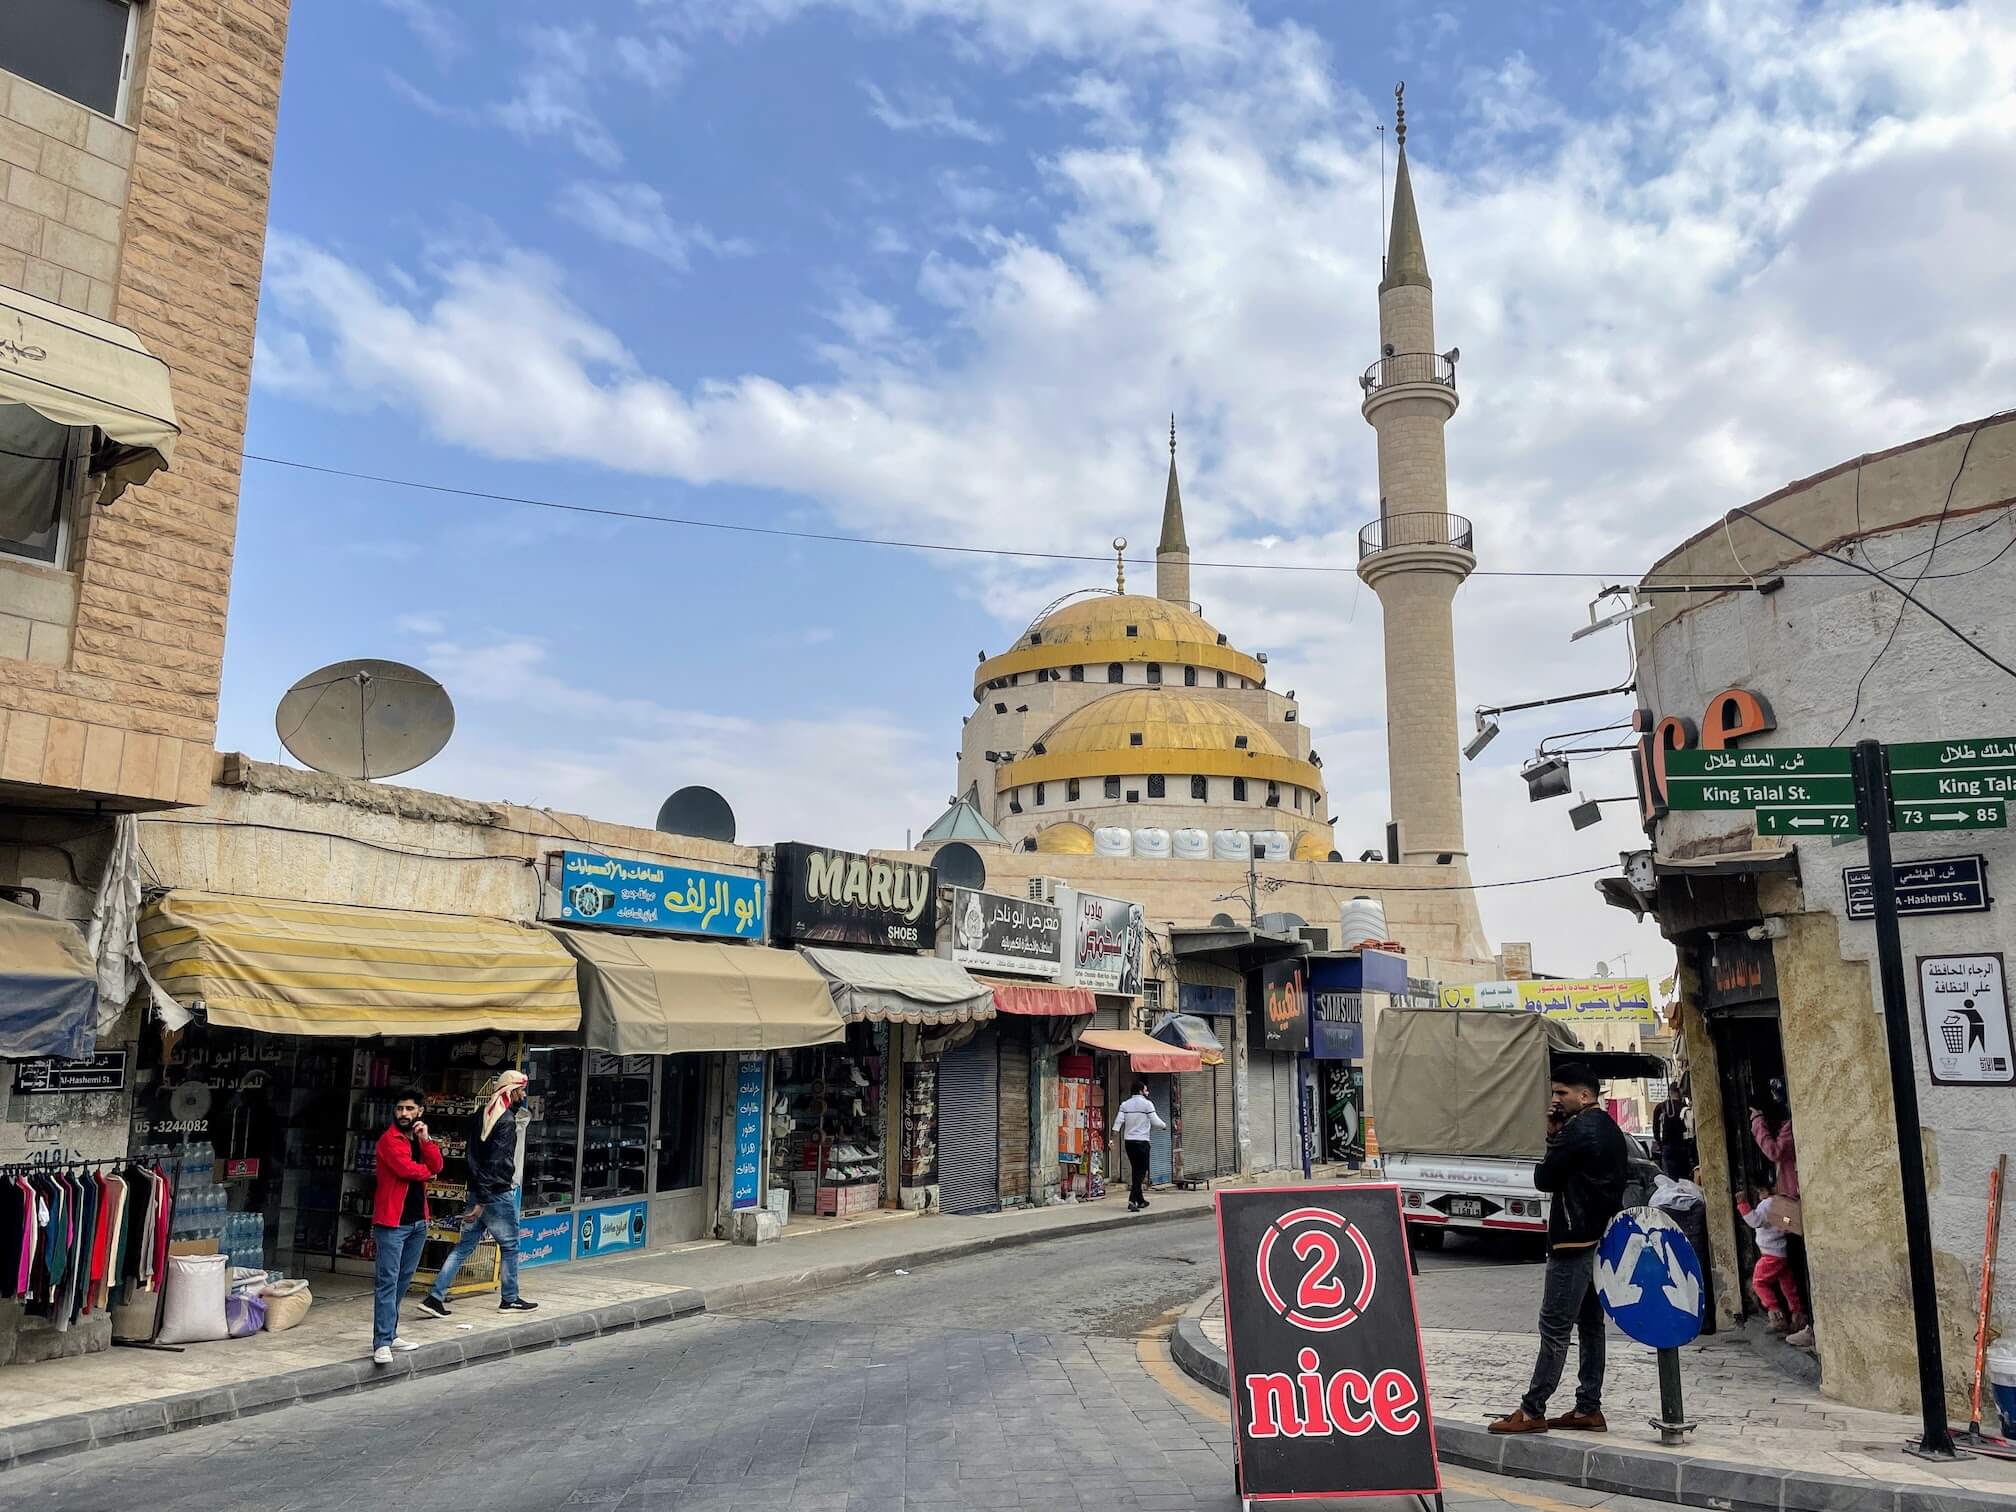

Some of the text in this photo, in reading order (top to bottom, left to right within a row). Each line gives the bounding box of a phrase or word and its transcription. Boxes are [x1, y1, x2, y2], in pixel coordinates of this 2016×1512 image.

[1740, 751, 1774, 768] الملك
[1940, 744, 1976, 763] طلال
[1704, 754, 1737, 771] طلال
[1703, 785, 1811, 803] King Talal St.
[1939, 778, 1981, 796] King
[1767, 815, 1850, 829] 1 72
[1903, 808, 1998, 824] 73 85
[1900, 867, 1936, 884] الهاشمي
[805, 852, 930, 924] MARLY
[1953, 891, 1967, 902] St.
[663, 878, 730, 930] الزلف
[1084, 898, 1103, 921] مادبا
[990, 903, 1011, 924] نادر
[1026, 911, 1059, 933] معرض
[887, 925, 918, 941] SHOES
[1929, 963, 1994, 978] الرجاء المحافظة
[1537, 984, 1567, 994] الدكتور
[1935, 981, 1969, 993] النظافة
[1613, 993, 1649, 1012] خليل
[240, 1042, 282, 1067] بقالة
[102, 1075, 112, 1084] St.
[135, 1120, 150, 1133] 05
[1292, 1230, 1345, 1310] 2
[1246, 1347, 1420, 1438] nice
